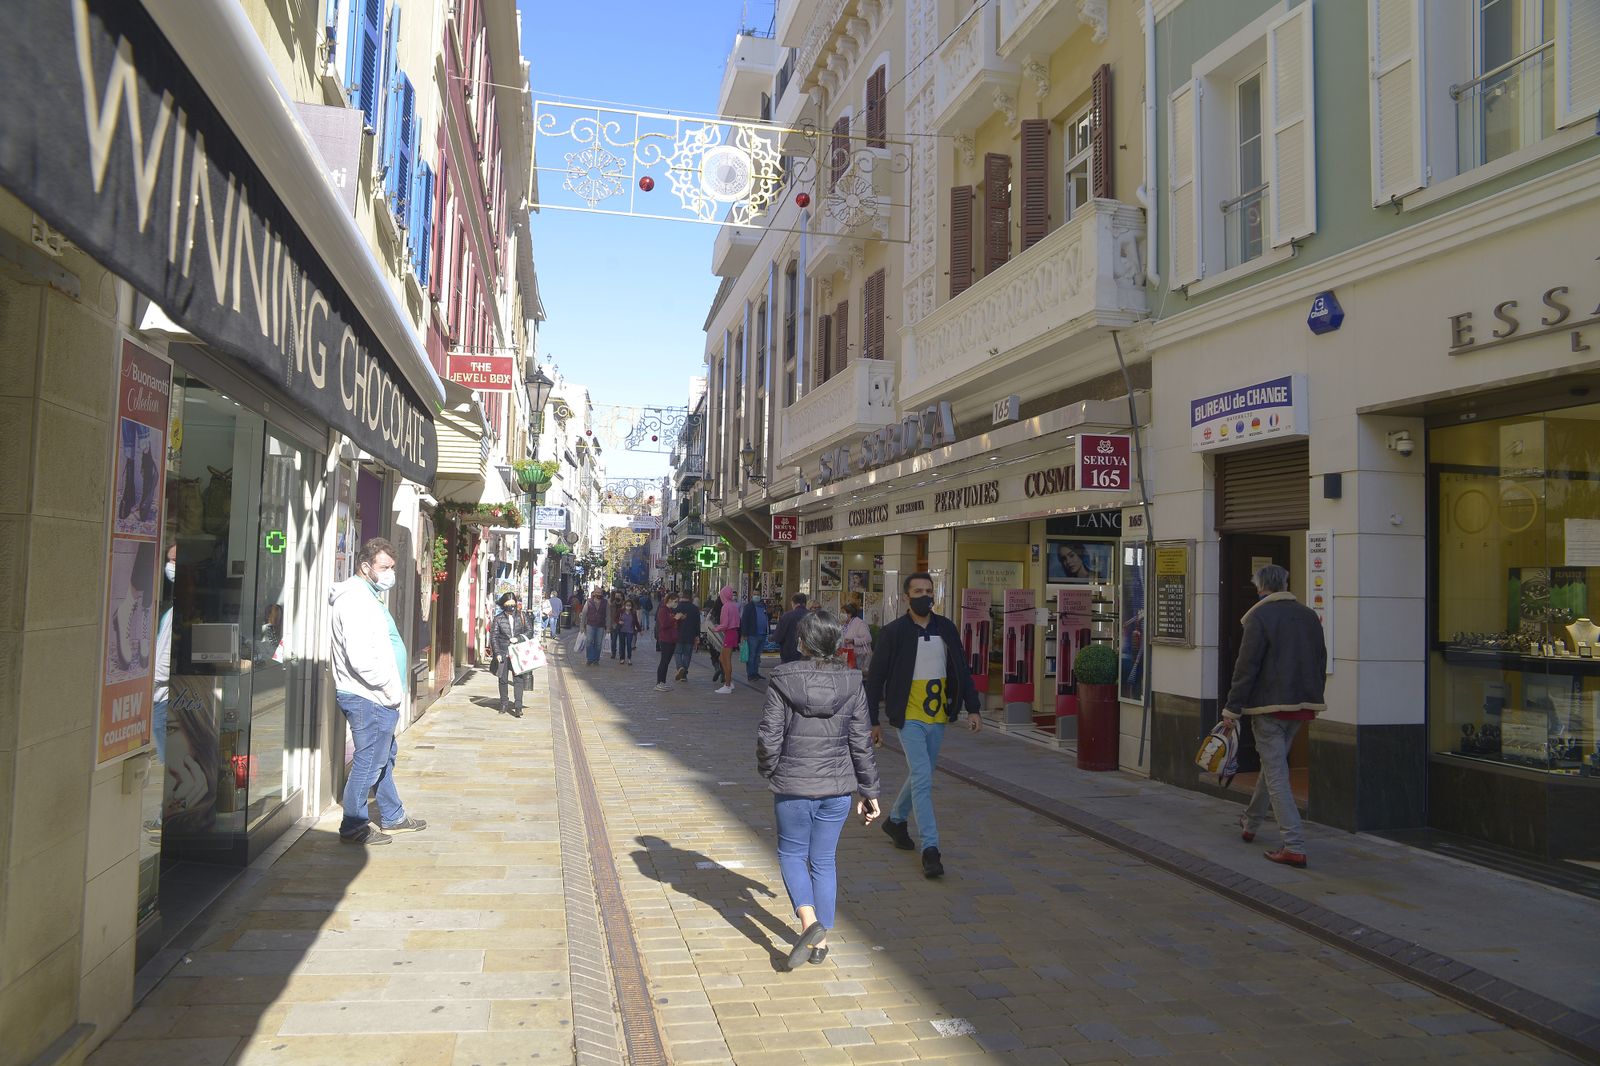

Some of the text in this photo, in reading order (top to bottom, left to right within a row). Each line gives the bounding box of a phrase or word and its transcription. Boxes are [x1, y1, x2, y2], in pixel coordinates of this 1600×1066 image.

[72, 0, 426, 468] WINNING CHOCOLATE
[1310, 309, 1329, 319] Chubb
[1447, 286, 1600, 349] ESS
[131, 363, 169, 396] Buonarotti
[450, 372, 510, 384] JEWEL BOX
[470, 362, 492, 373] THE
[127, 387, 160, 413] Collection
[994, 402, 1010, 419] 165
[1194, 395, 1231, 422] BUREAU
[1232, 392, 1246, 409] de
[1247, 386, 1288, 407] CHANGE
[1083, 455, 1128, 466] SERUYA
[1090, 469, 1121, 487] 165
[848, 503, 889, 527] COSMETICS
[934, 479, 1000, 513] PERFUMES
[1024, 463, 1075, 499] COSM
[777, 531, 793, 540] 165
[111, 692, 143, 723] NEW
[923, 678, 943, 718] 8
[103, 719, 147, 747] COLLECTION
